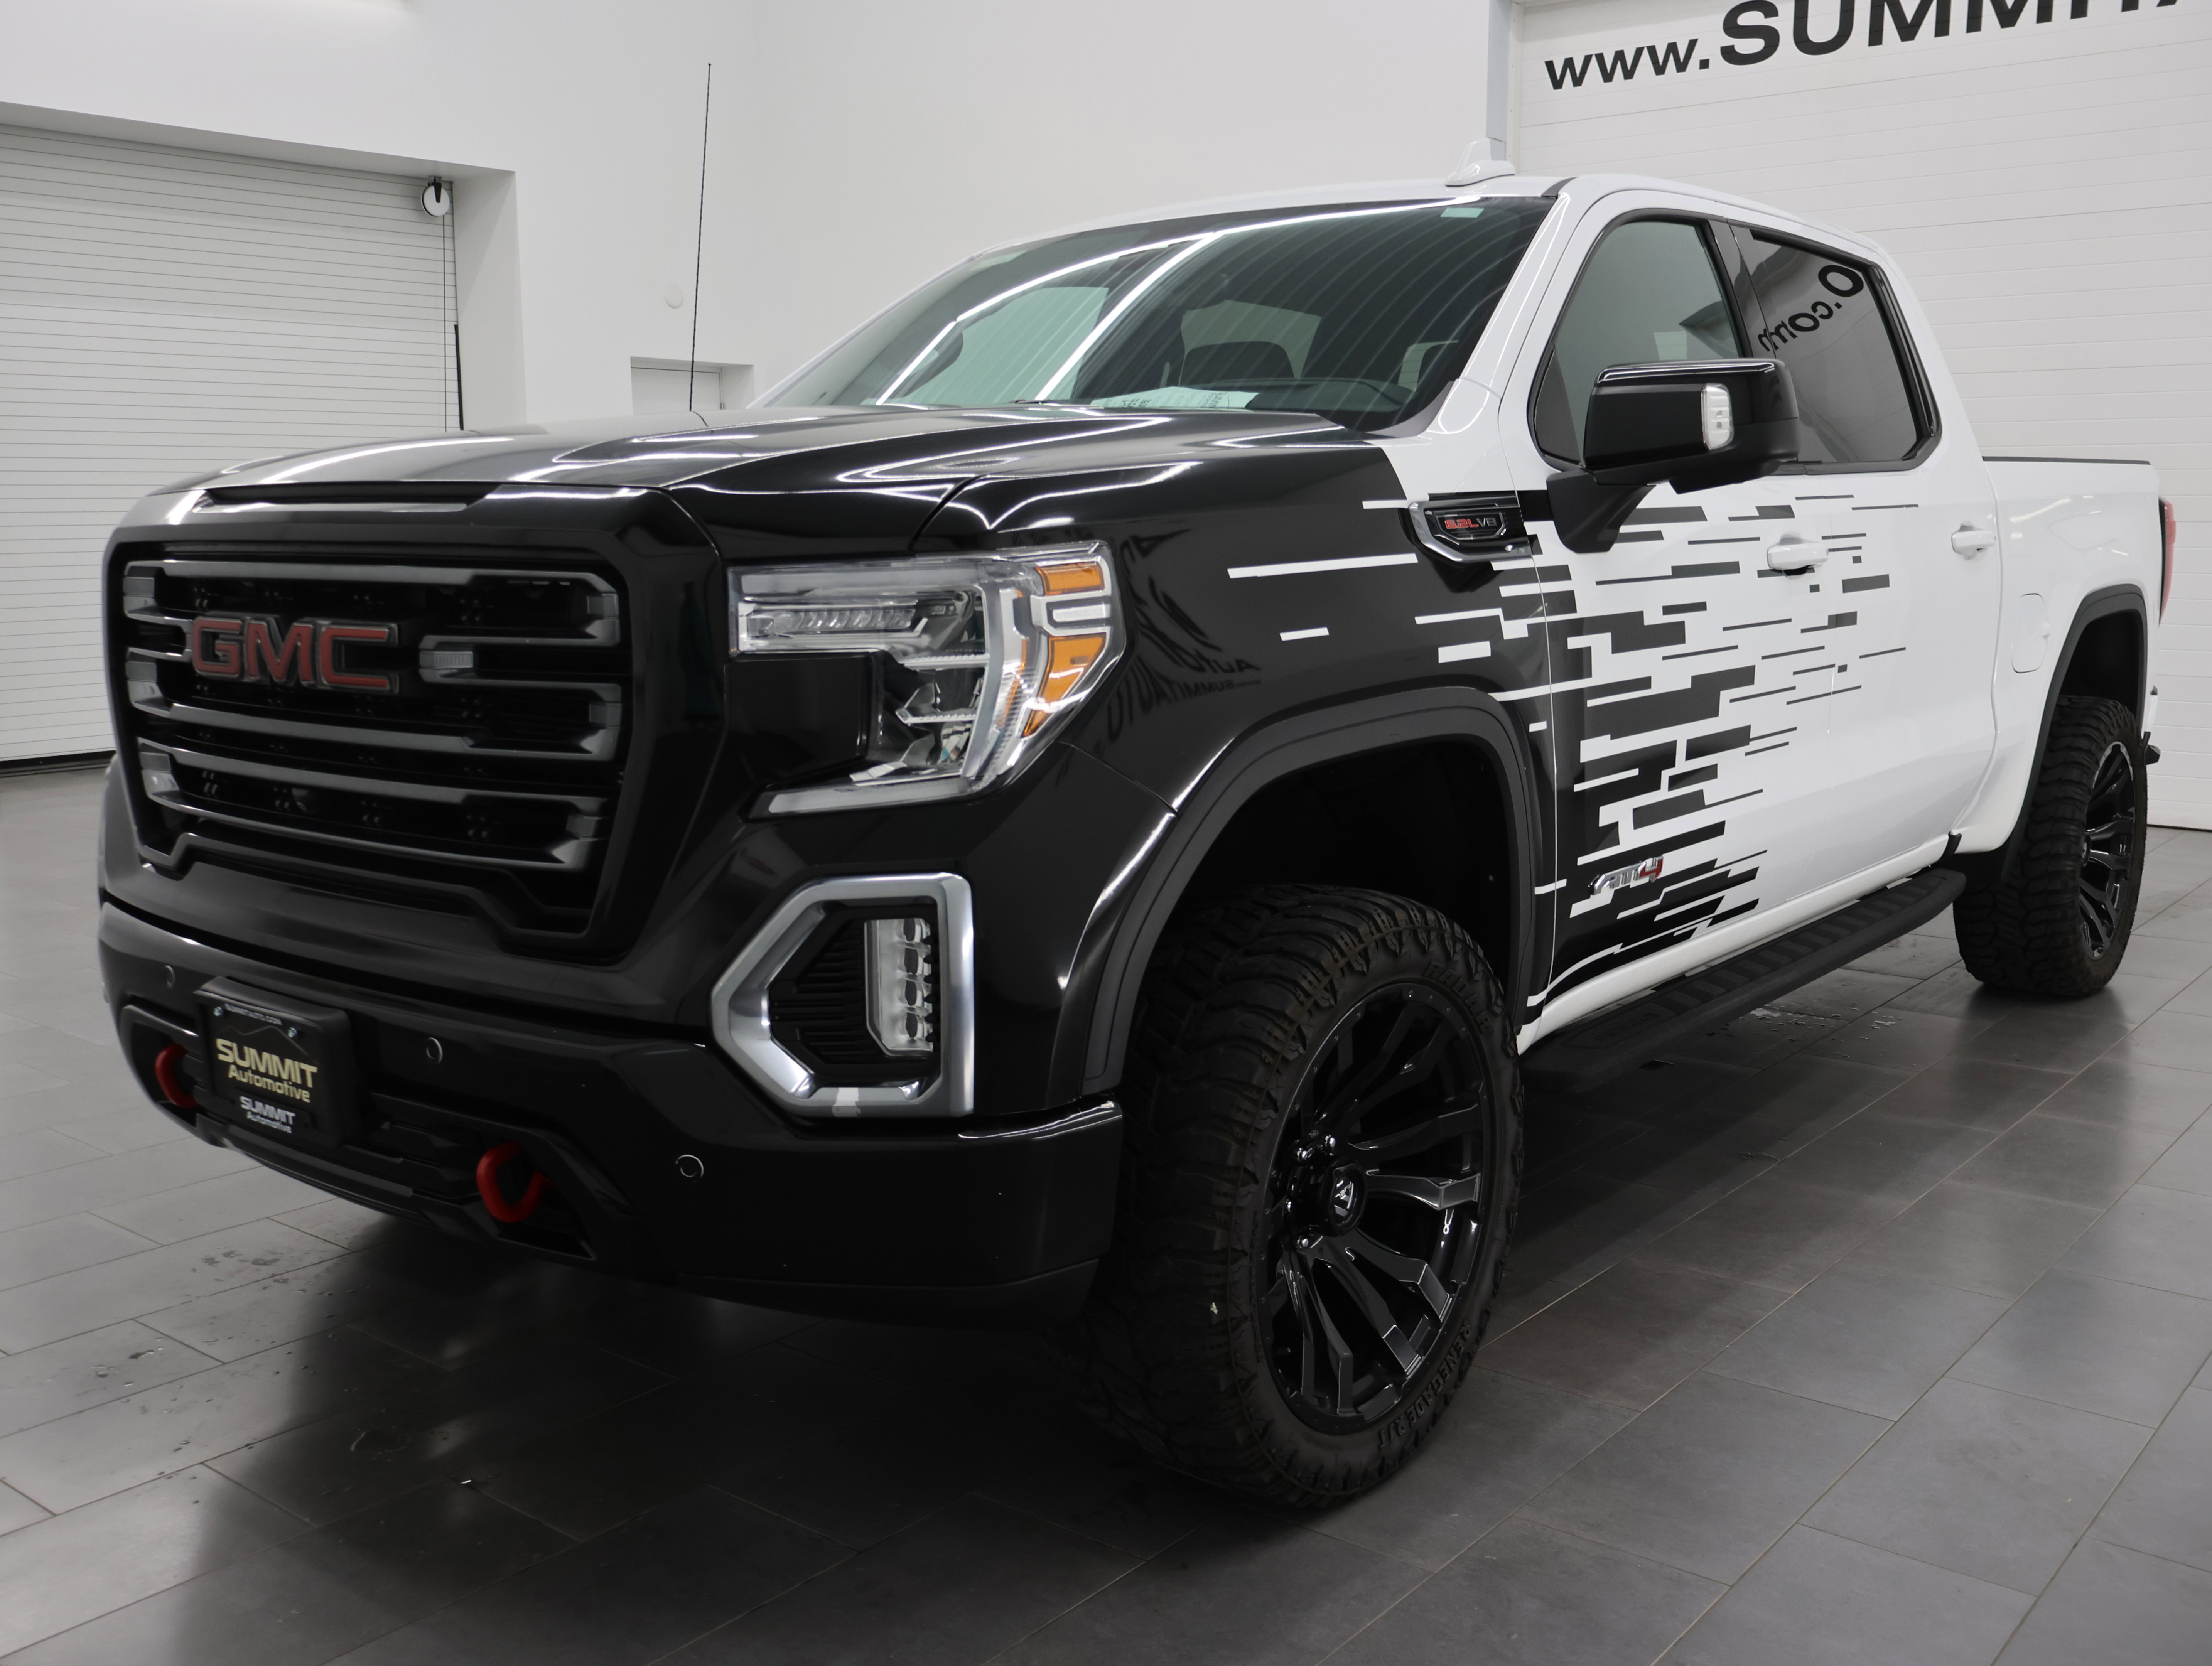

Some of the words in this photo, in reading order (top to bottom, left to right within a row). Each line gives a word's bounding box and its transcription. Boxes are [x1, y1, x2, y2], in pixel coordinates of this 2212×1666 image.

[193, 616, 394, 691] GMC
[1588, 855, 1664, 895] AT4
[1422, 961, 1494, 1035] RADAR
[215, 1038, 318, 1088] SUMMIT
[228, 1064, 311, 1103] Automotive
[240, 1096, 295, 1124] SUMMIT
[246, 1111, 292, 1133] Automotive
[1405, 1319, 1471, 1426] RENEGADE
